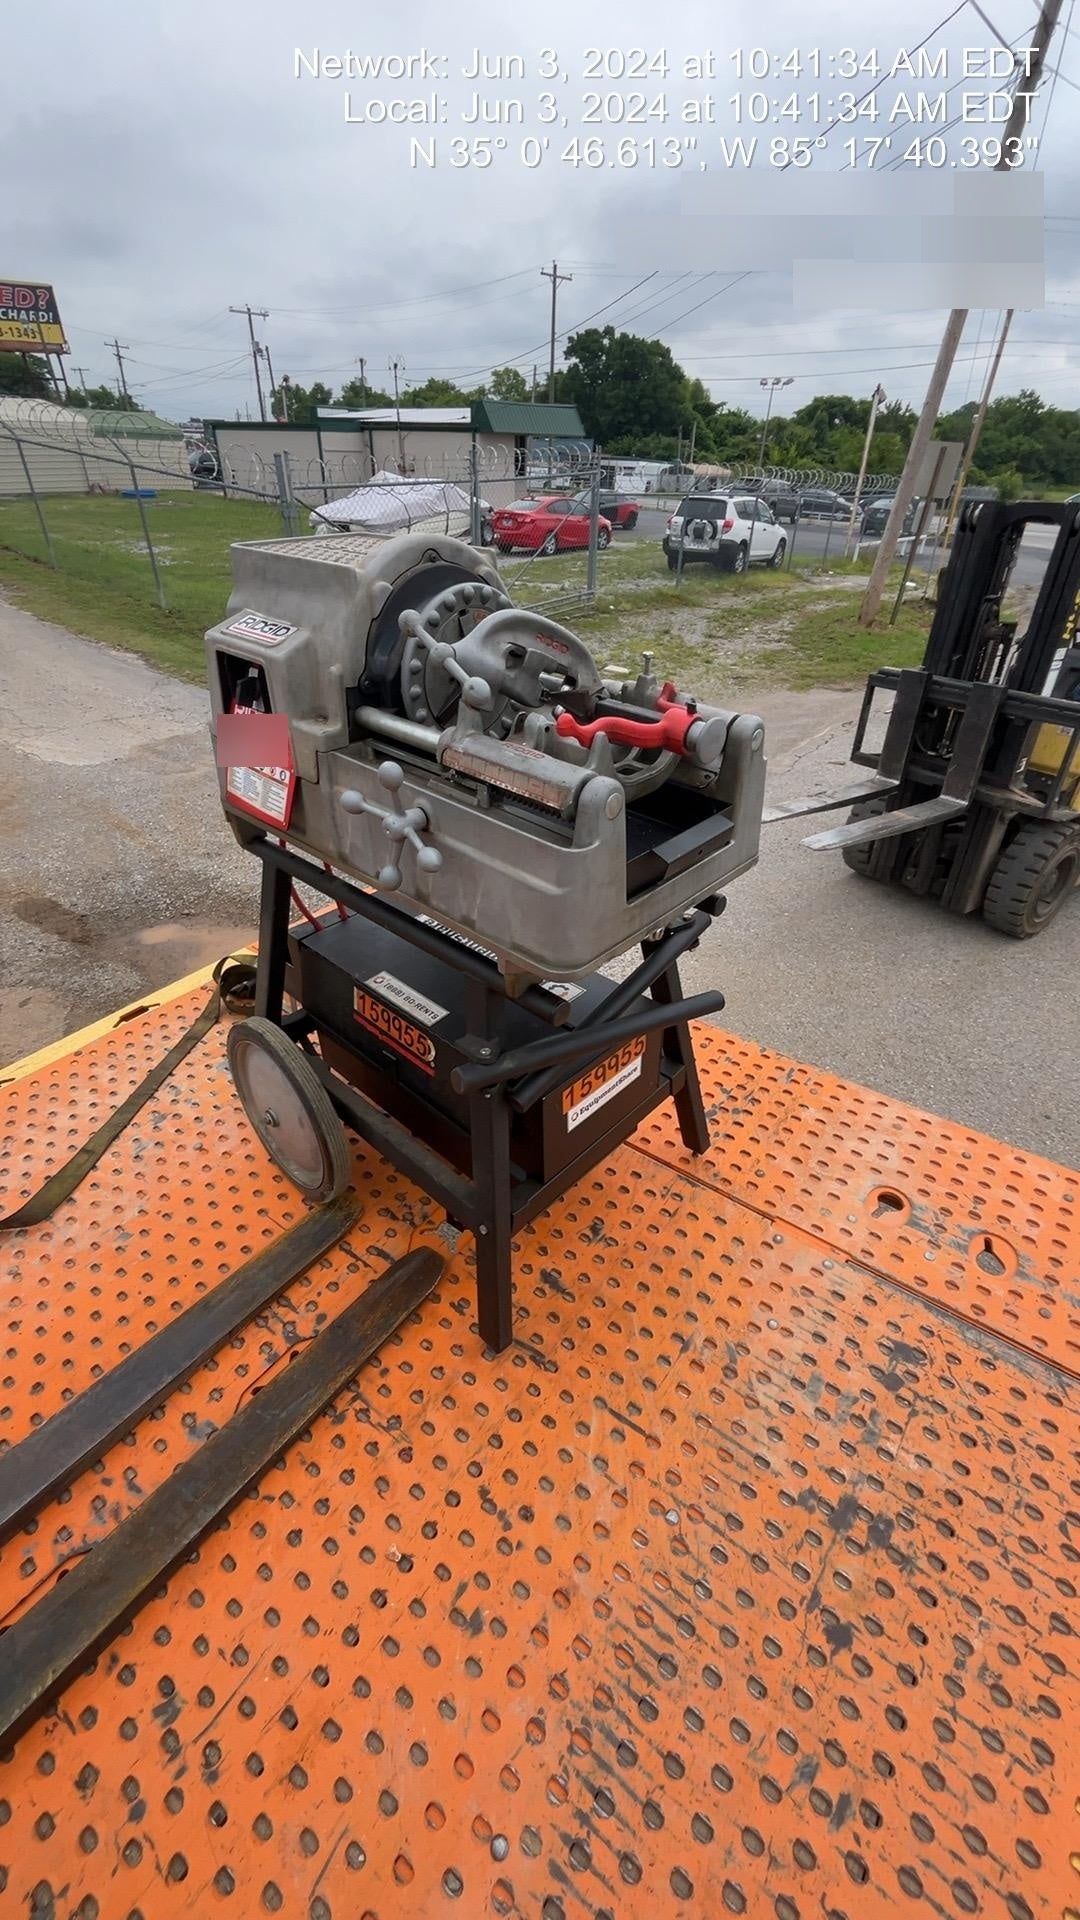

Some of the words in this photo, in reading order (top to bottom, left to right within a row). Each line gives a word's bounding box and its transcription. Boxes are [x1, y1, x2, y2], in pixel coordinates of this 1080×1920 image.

[237, 617, 291, 637] RIDGID
[359, 993, 431, 1057] 159955
[565, 1038, 645, 1107] 159955
[579, 1066, 639, 1116] EquipmentShare
